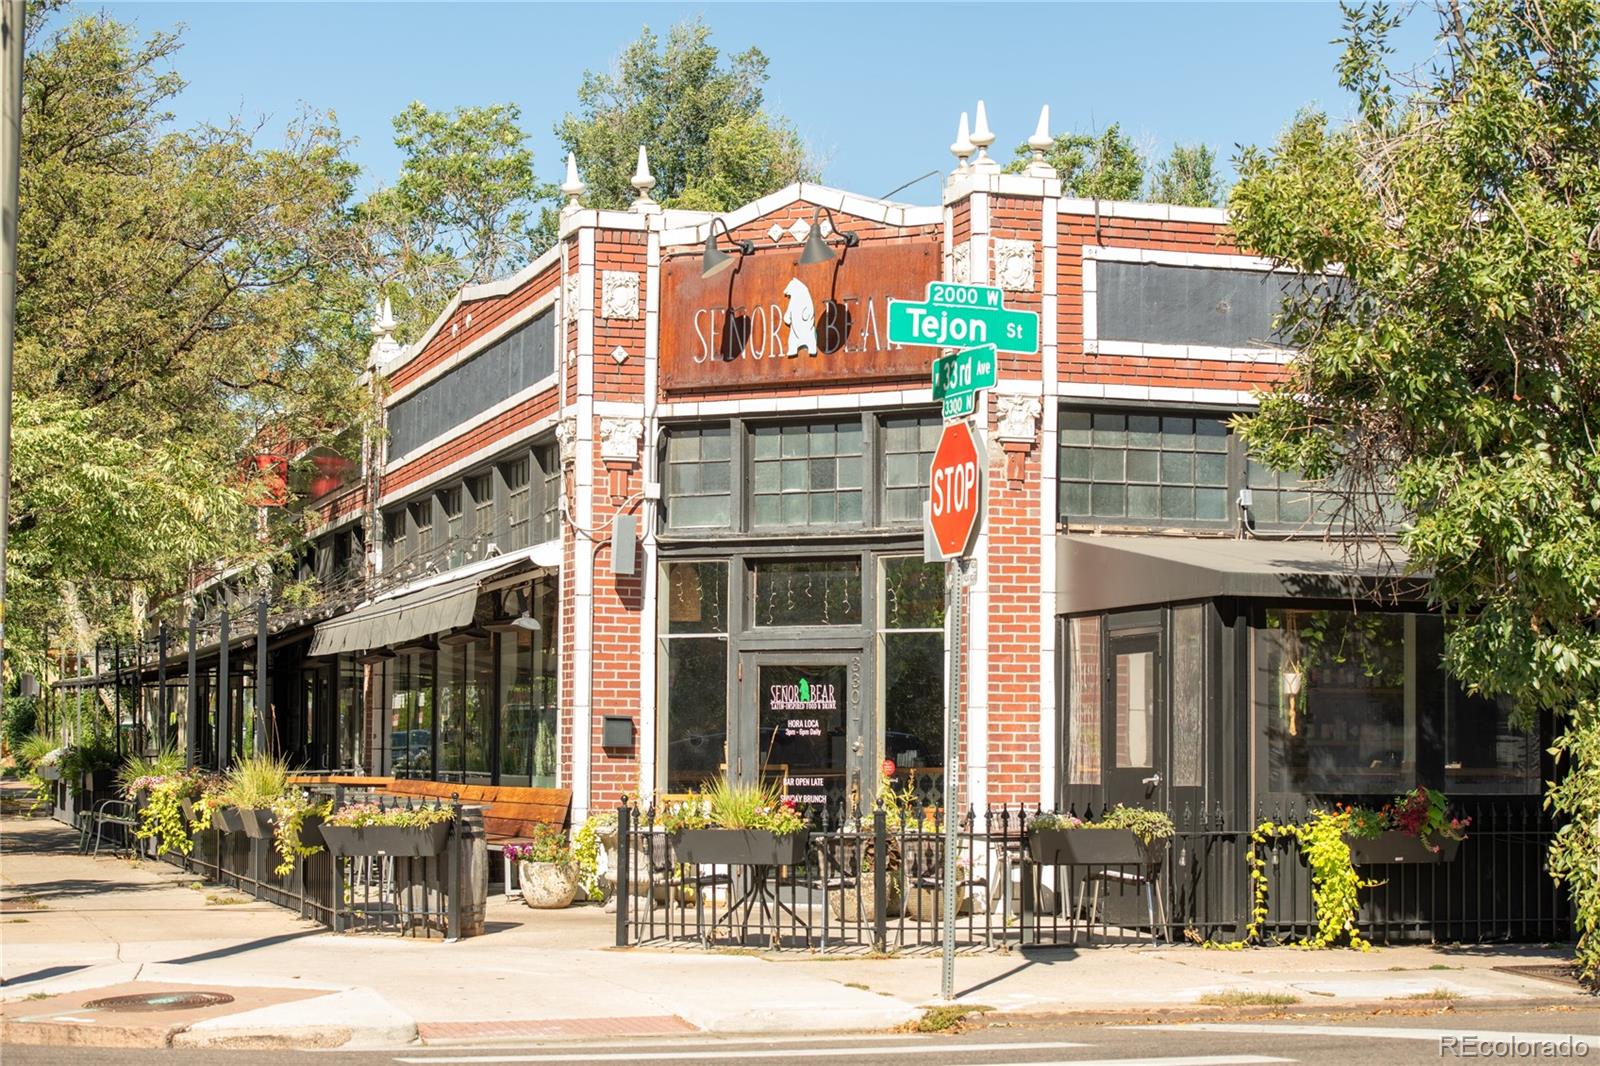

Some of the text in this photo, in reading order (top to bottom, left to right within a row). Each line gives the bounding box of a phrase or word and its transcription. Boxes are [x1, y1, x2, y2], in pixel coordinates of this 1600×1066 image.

[933, 285, 1000, 307] 2000 W
[823, 297, 903, 352] BEA
[905, 307, 1023, 344] Tejon St
[943, 356, 972, 391] 33rd
[976, 360, 991, 376] Ave
[944, 394, 972, 415] 3300 N
[933, 461, 975, 517] STOP
[810, 684, 835, 702] BEAR
[787, 719, 819, 728] HORA LOCA
[810, 728, 821, 736] Daily
[795, 777, 810, 786] OPEN
[811, 777, 824, 786] LATE
[803, 794, 827, 804] BRUNCH
